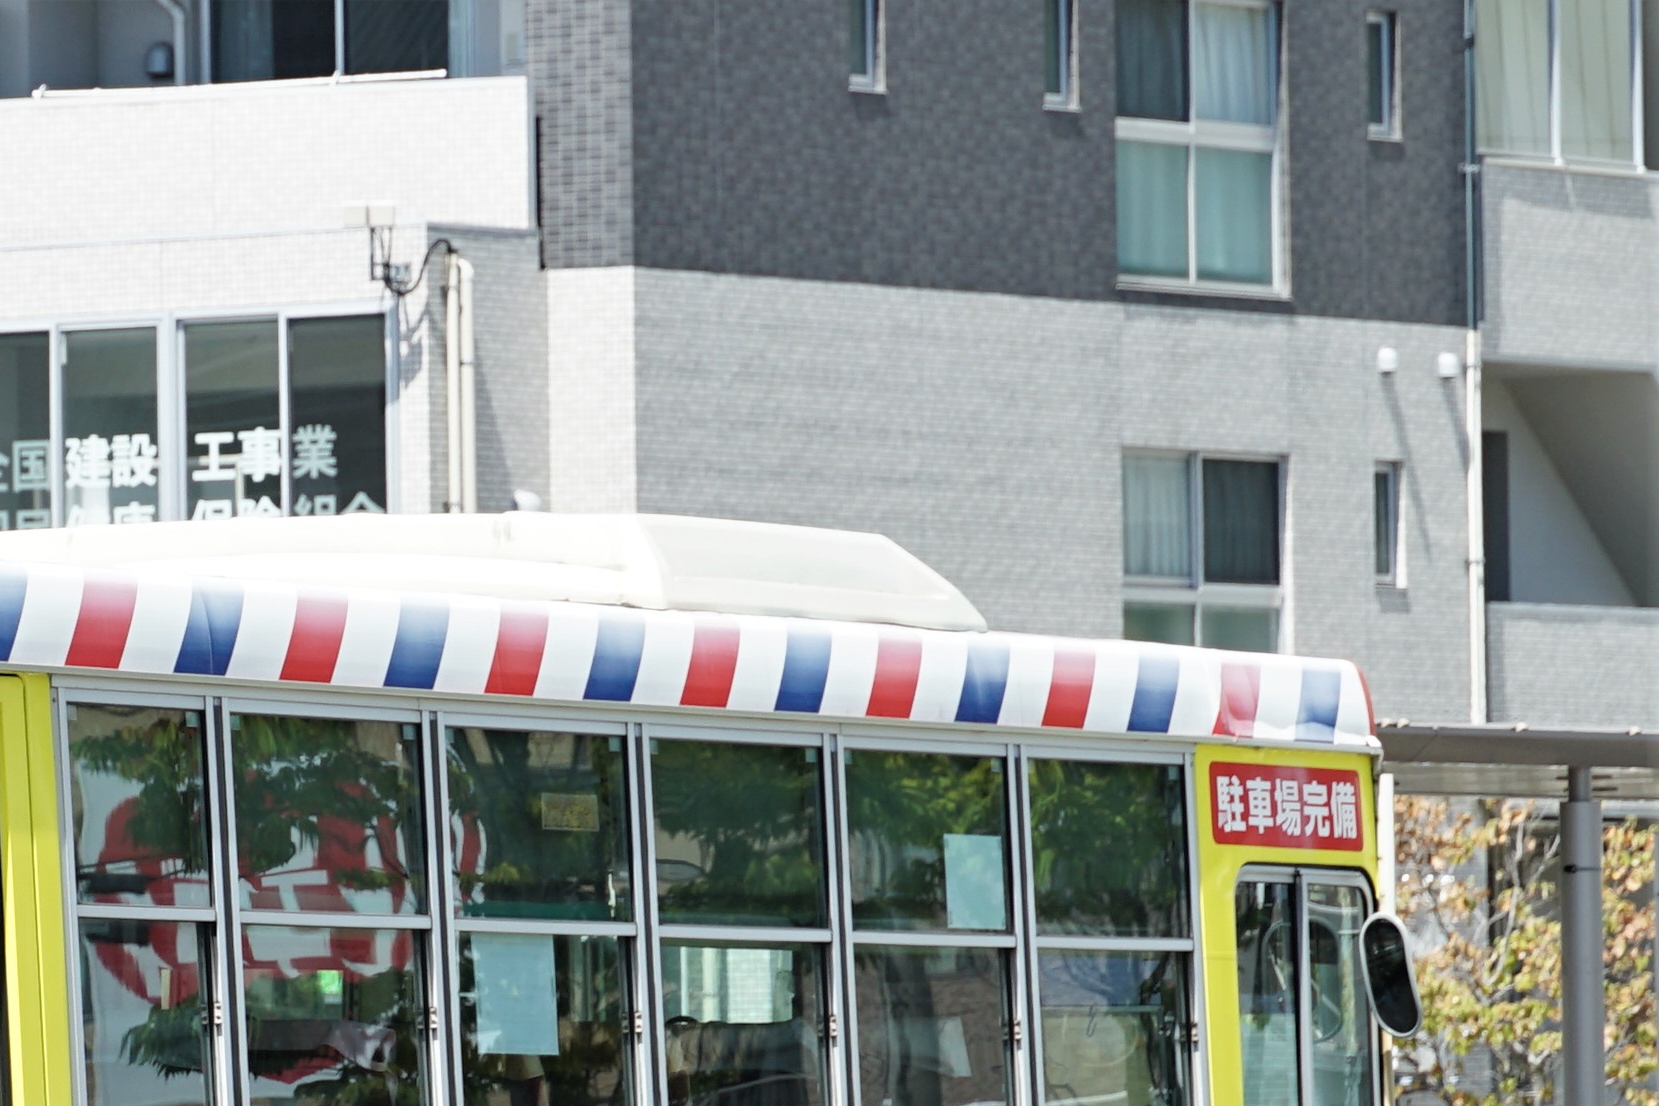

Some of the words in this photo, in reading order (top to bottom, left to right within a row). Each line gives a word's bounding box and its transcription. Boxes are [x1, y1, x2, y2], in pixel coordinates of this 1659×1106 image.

[1215, 775, 1358, 839] 駐車場完備
